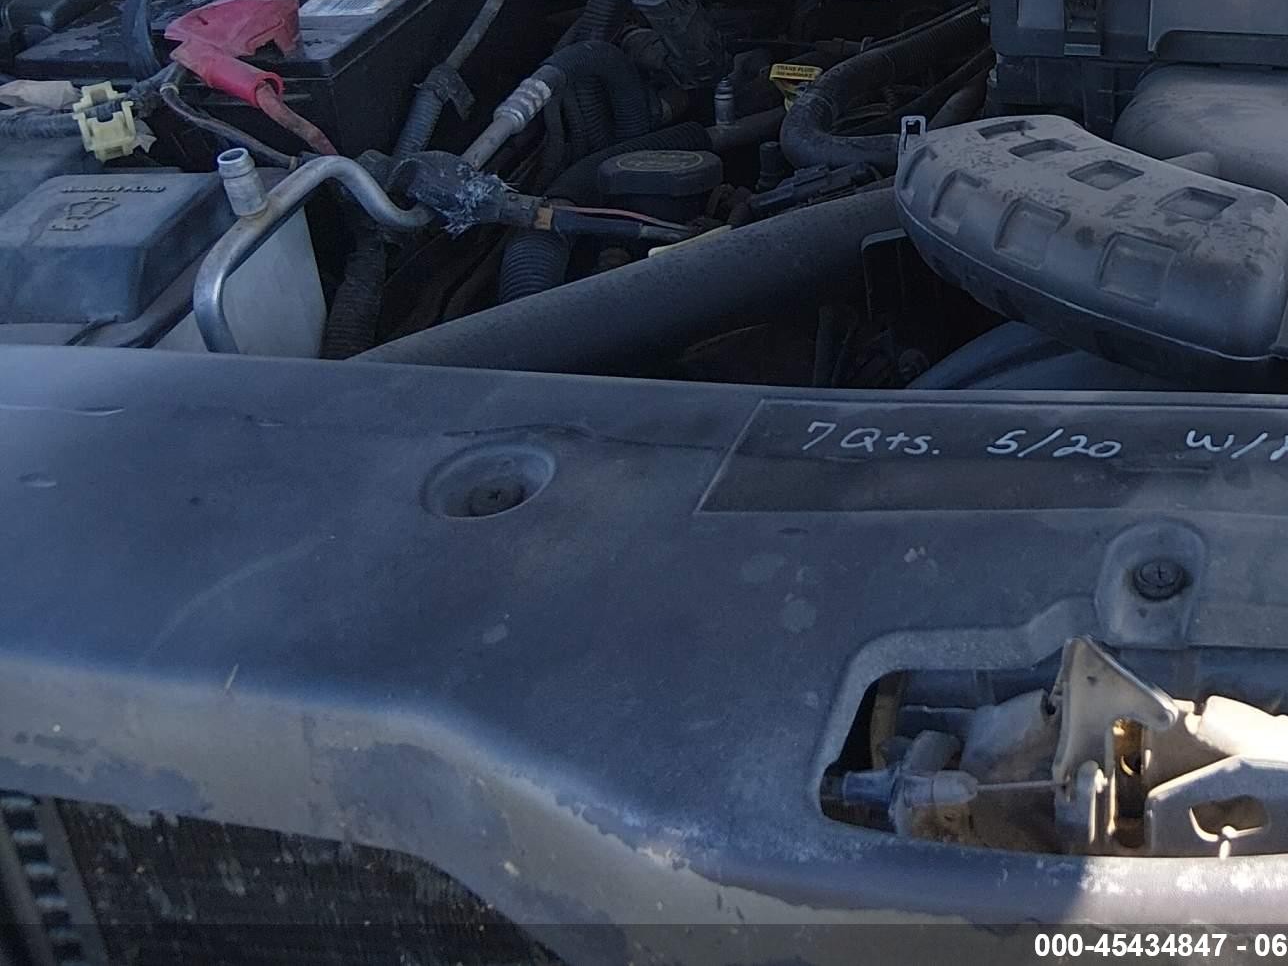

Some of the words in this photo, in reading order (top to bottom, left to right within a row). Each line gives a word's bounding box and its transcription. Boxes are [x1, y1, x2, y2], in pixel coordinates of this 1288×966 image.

[801, 420, 838, 452] 7
[839, 427, 941, 455] Qts.
[987, 427, 1123, 459] 5/20
